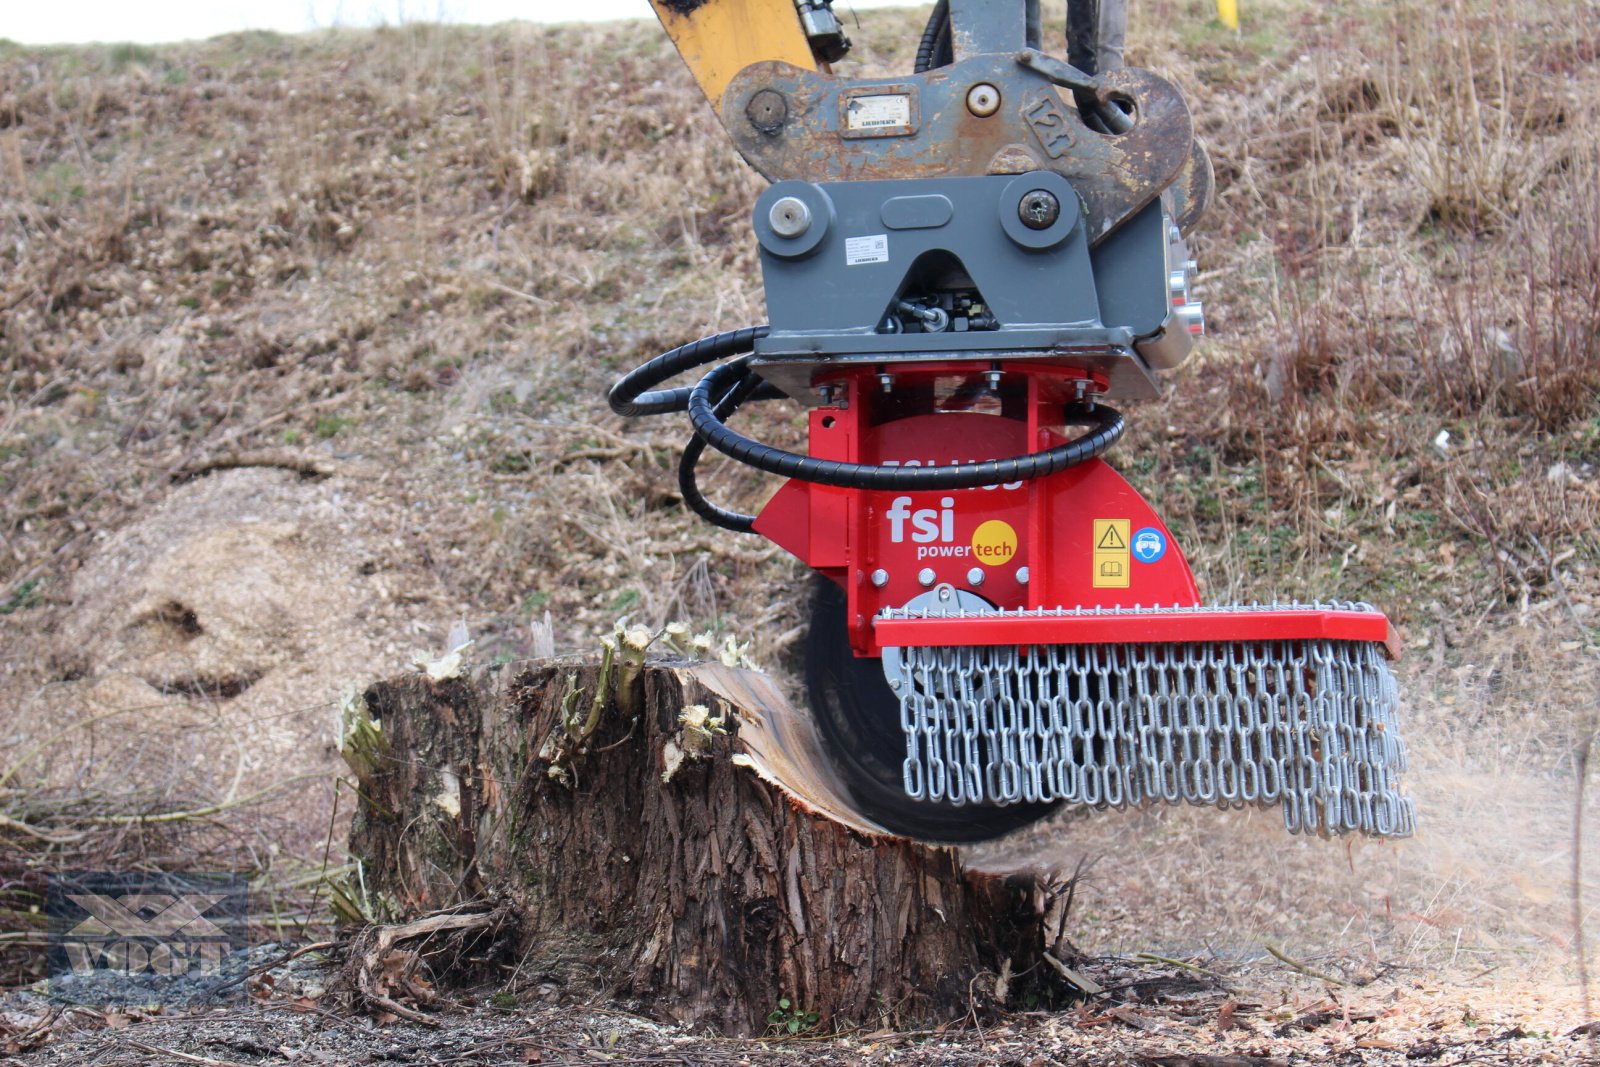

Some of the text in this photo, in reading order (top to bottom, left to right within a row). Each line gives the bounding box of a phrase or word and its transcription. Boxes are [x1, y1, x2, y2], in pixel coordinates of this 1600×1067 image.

[886, 496, 955, 543] fsi
[917, 542, 1012, 560] power tech
